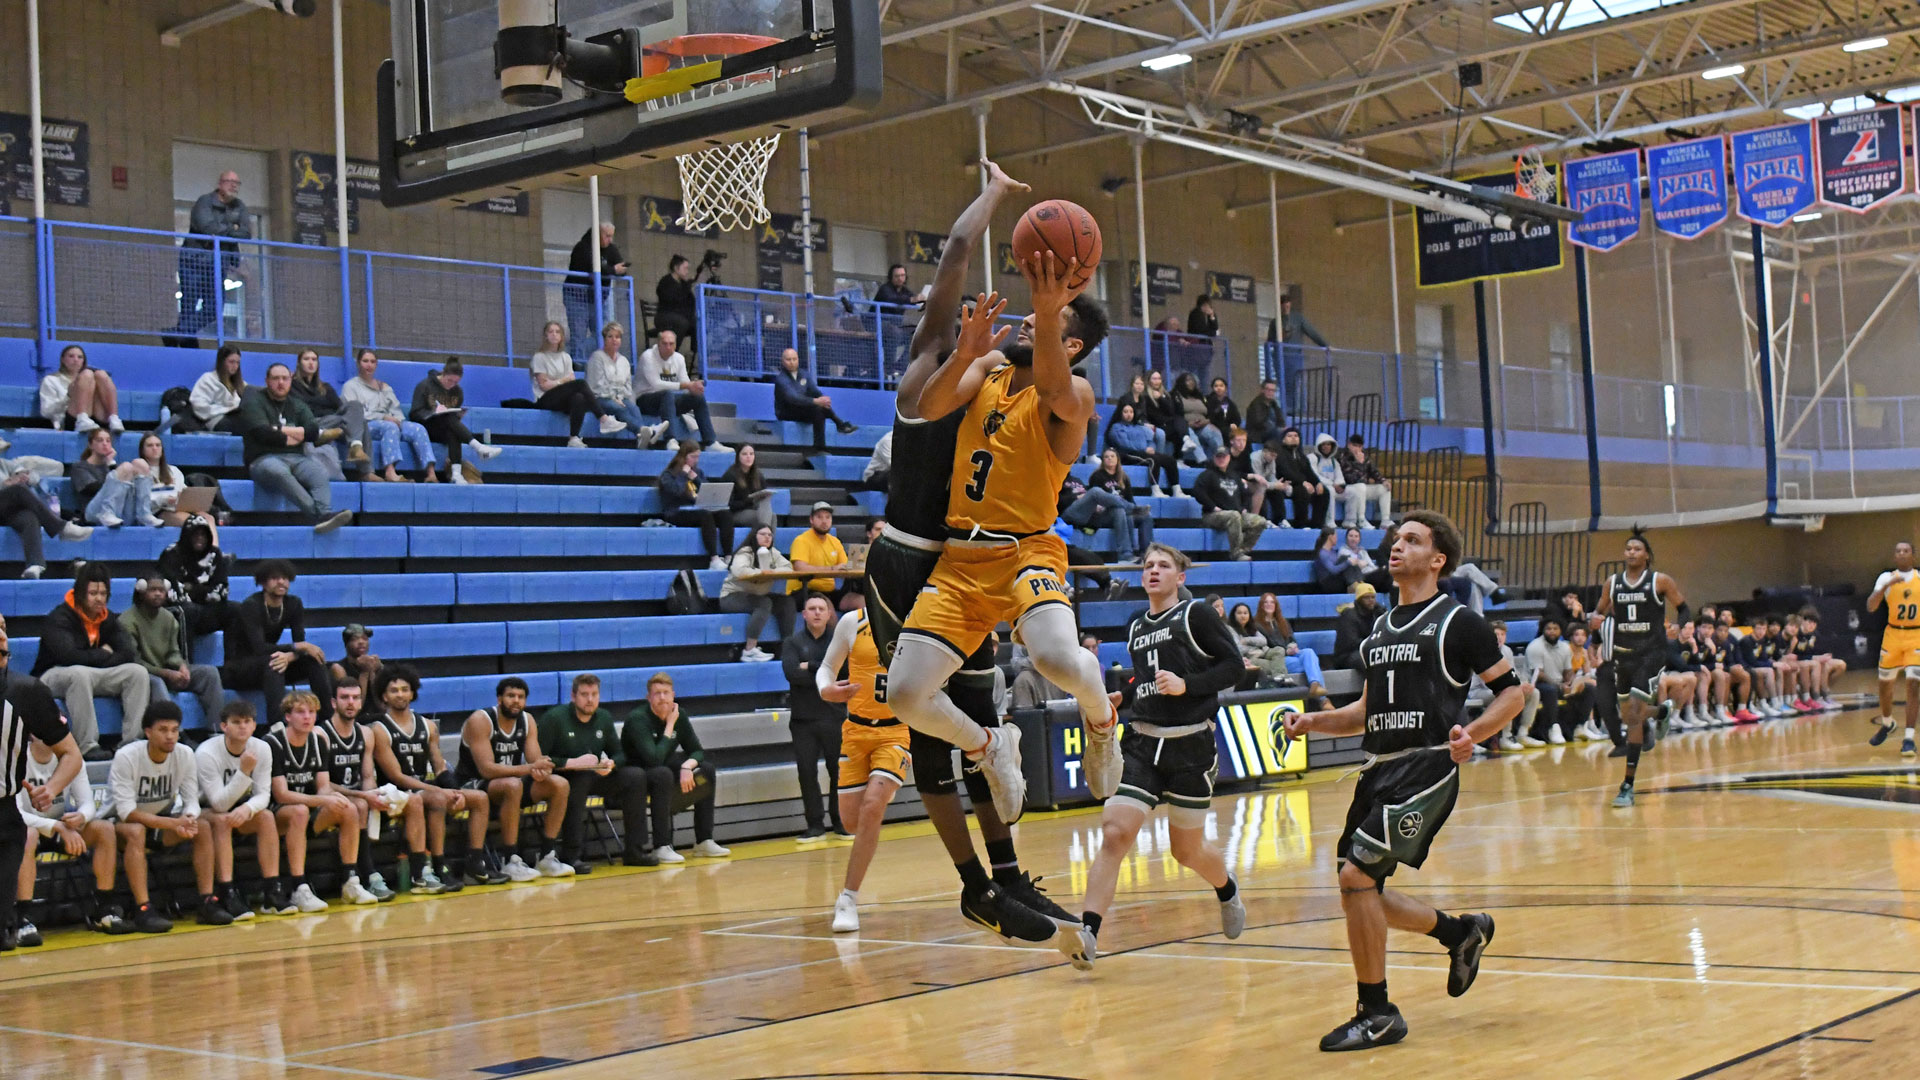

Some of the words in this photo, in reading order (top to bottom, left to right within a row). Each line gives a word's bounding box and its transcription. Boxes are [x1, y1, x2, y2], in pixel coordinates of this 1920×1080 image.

[41, 124, 77, 139] LARKE
[1830, 119, 1885, 136] BASKETBALL
[1746, 136, 1798, 151] BASKETBALL
[1660, 151, 1711, 165] BASKETBALL
[1577, 164, 1626, 178] BASKETBALL
[1746, 157, 1803, 187] NAIA
[1827, 171, 1897, 190] CONFERENCE
[1660, 171, 1716, 200] NAIA
[1786, 187, 1798, 196] OF
[1834, 180, 1890, 196] CHAMPION
[1578, 185, 1631, 212] NAIA
[1656, 203, 1722, 220] QUARTERFINAL
[965, 449, 994, 502] 3
[1617, 592, 1647, 602] CENTRAL
[1628, 604, 1637, 621] 0
[1897, 604, 1917, 620] 20
[1133, 627, 1172, 650] CENTRAL
[1147, 649, 1159, 672] 4
[1369, 644, 1421, 667] CENTRAL
[874, 673, 888, 704] 5
[1386, 670, 1395, 704] 1
[1368, 711, 1425, 732] METHODIST
[138, 774, 172, 797] CMU
